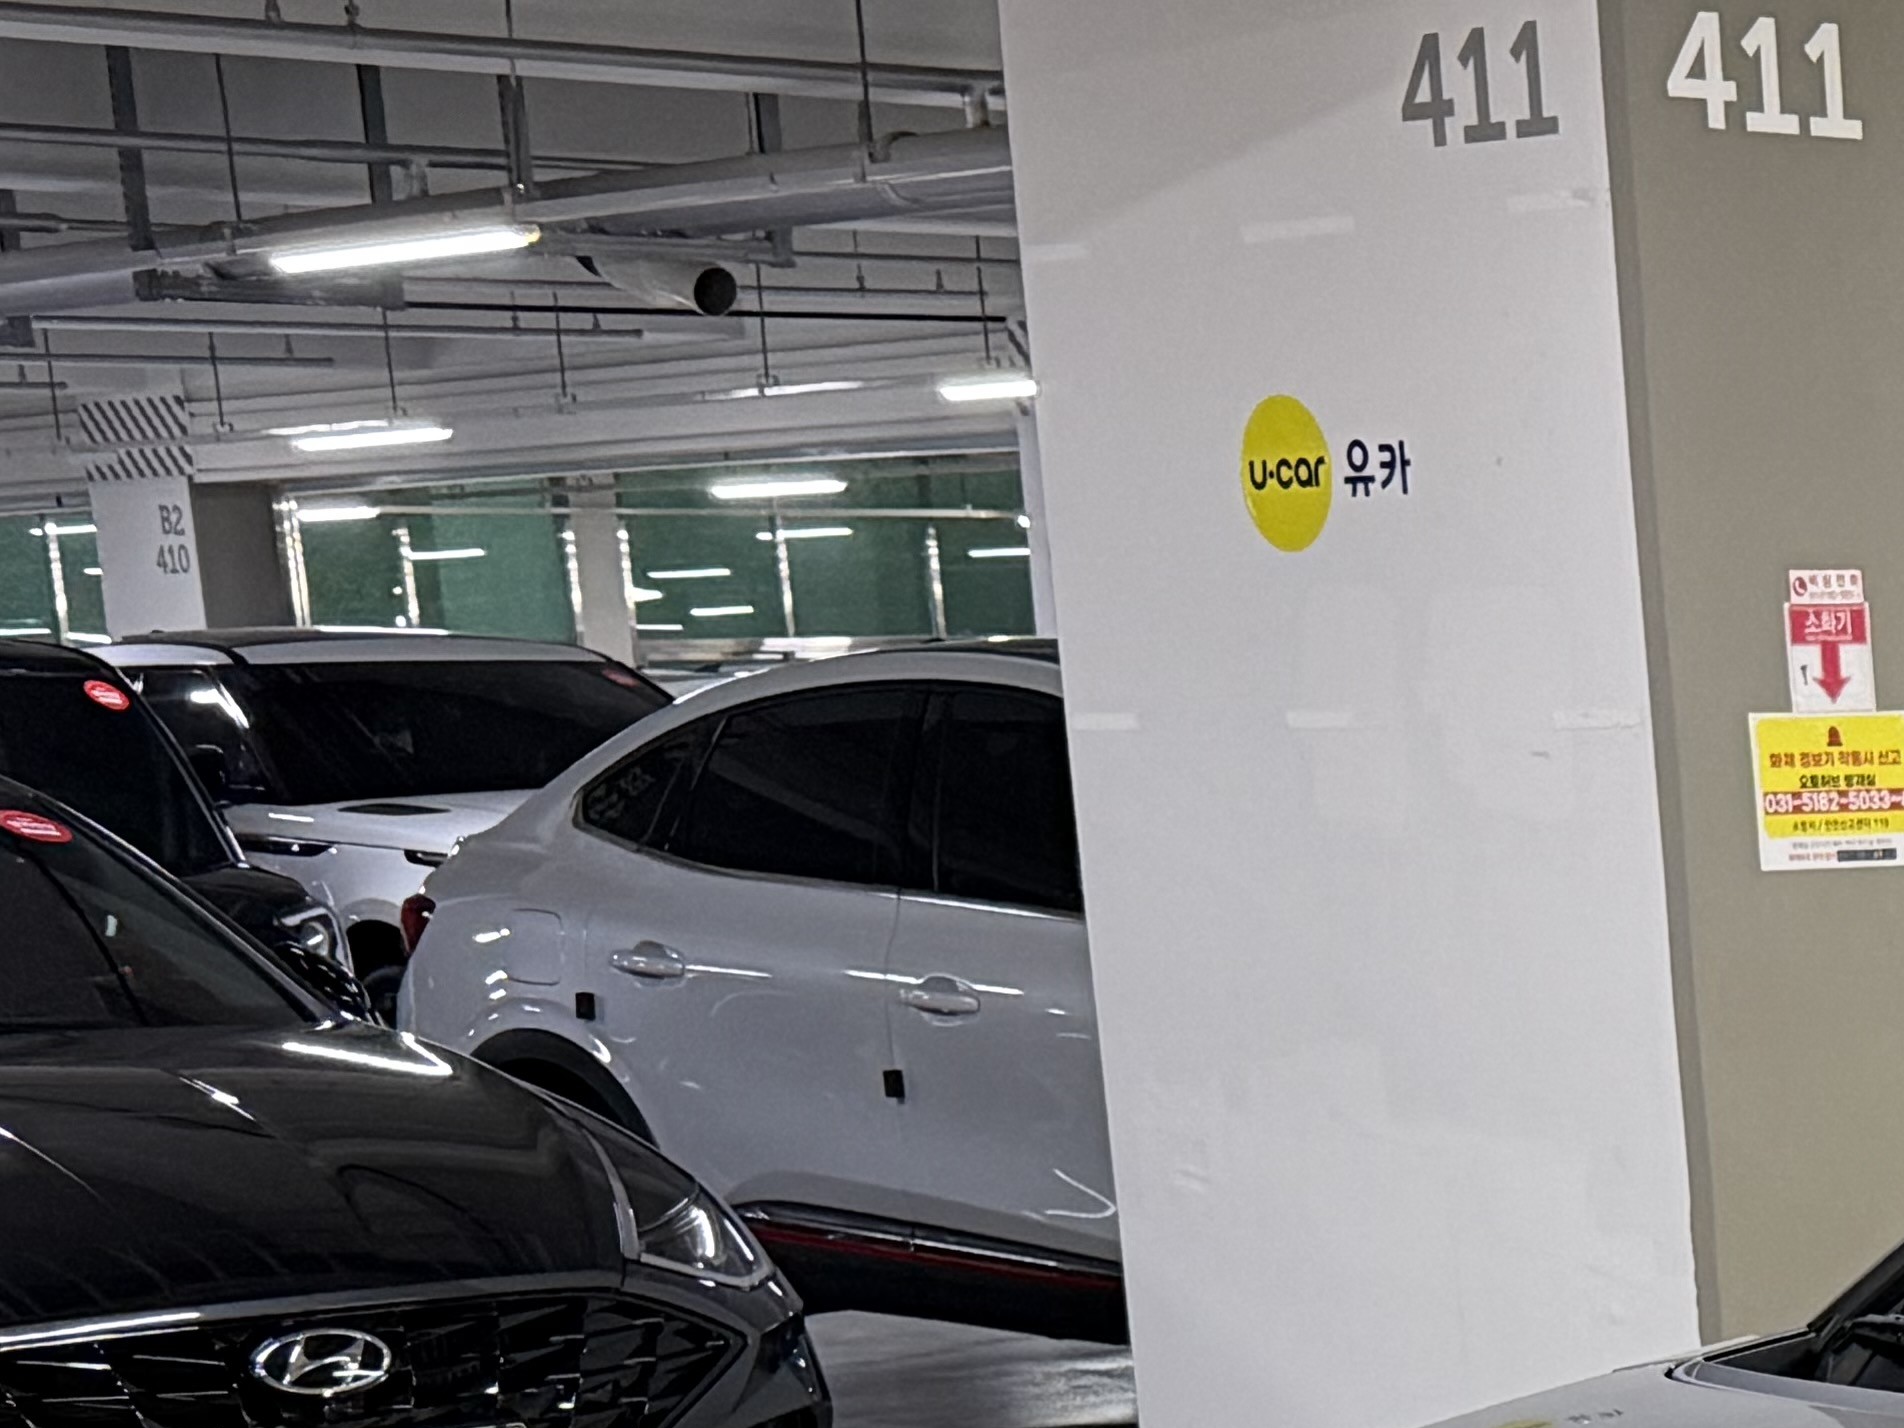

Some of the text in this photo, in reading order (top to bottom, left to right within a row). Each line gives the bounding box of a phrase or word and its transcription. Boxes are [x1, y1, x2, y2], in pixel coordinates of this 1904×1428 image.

[1401, 19, 1560, 147] 411
[1666, 11, 1864, 141] 411
[208, 438, 518, 526] 357누 1762
[1343, 437, 1411, 498] 유카
[158, 503, 185, 536] B2
[156, 543, 190, 574] 410
[1804, 609, 1852, 634] 소화기
